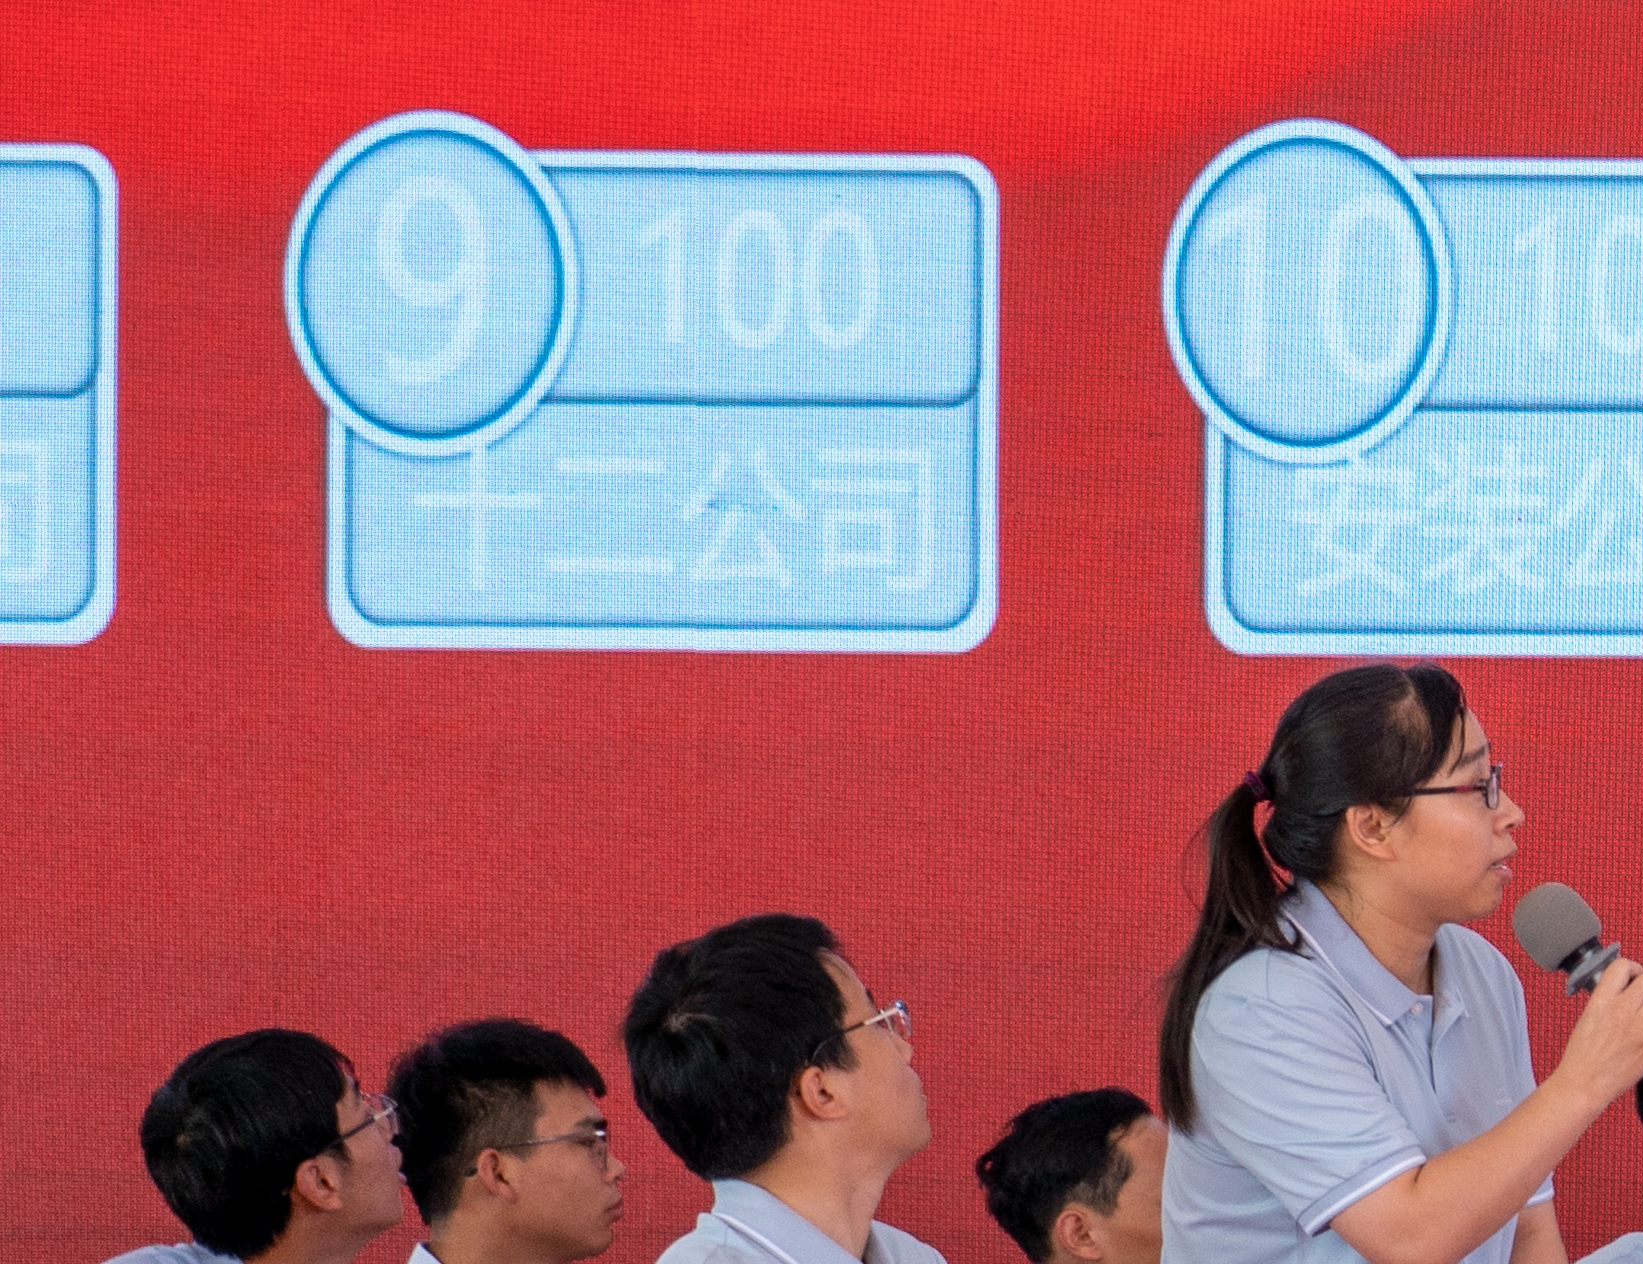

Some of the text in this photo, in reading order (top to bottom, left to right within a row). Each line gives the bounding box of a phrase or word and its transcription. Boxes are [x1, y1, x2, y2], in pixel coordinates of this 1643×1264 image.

[377, 175, 484, 384] 9
[640, 208, 877, 348] 100
[1205, 196, 1420, 381] 10
[411, 446, 932, 590] 十二公司
